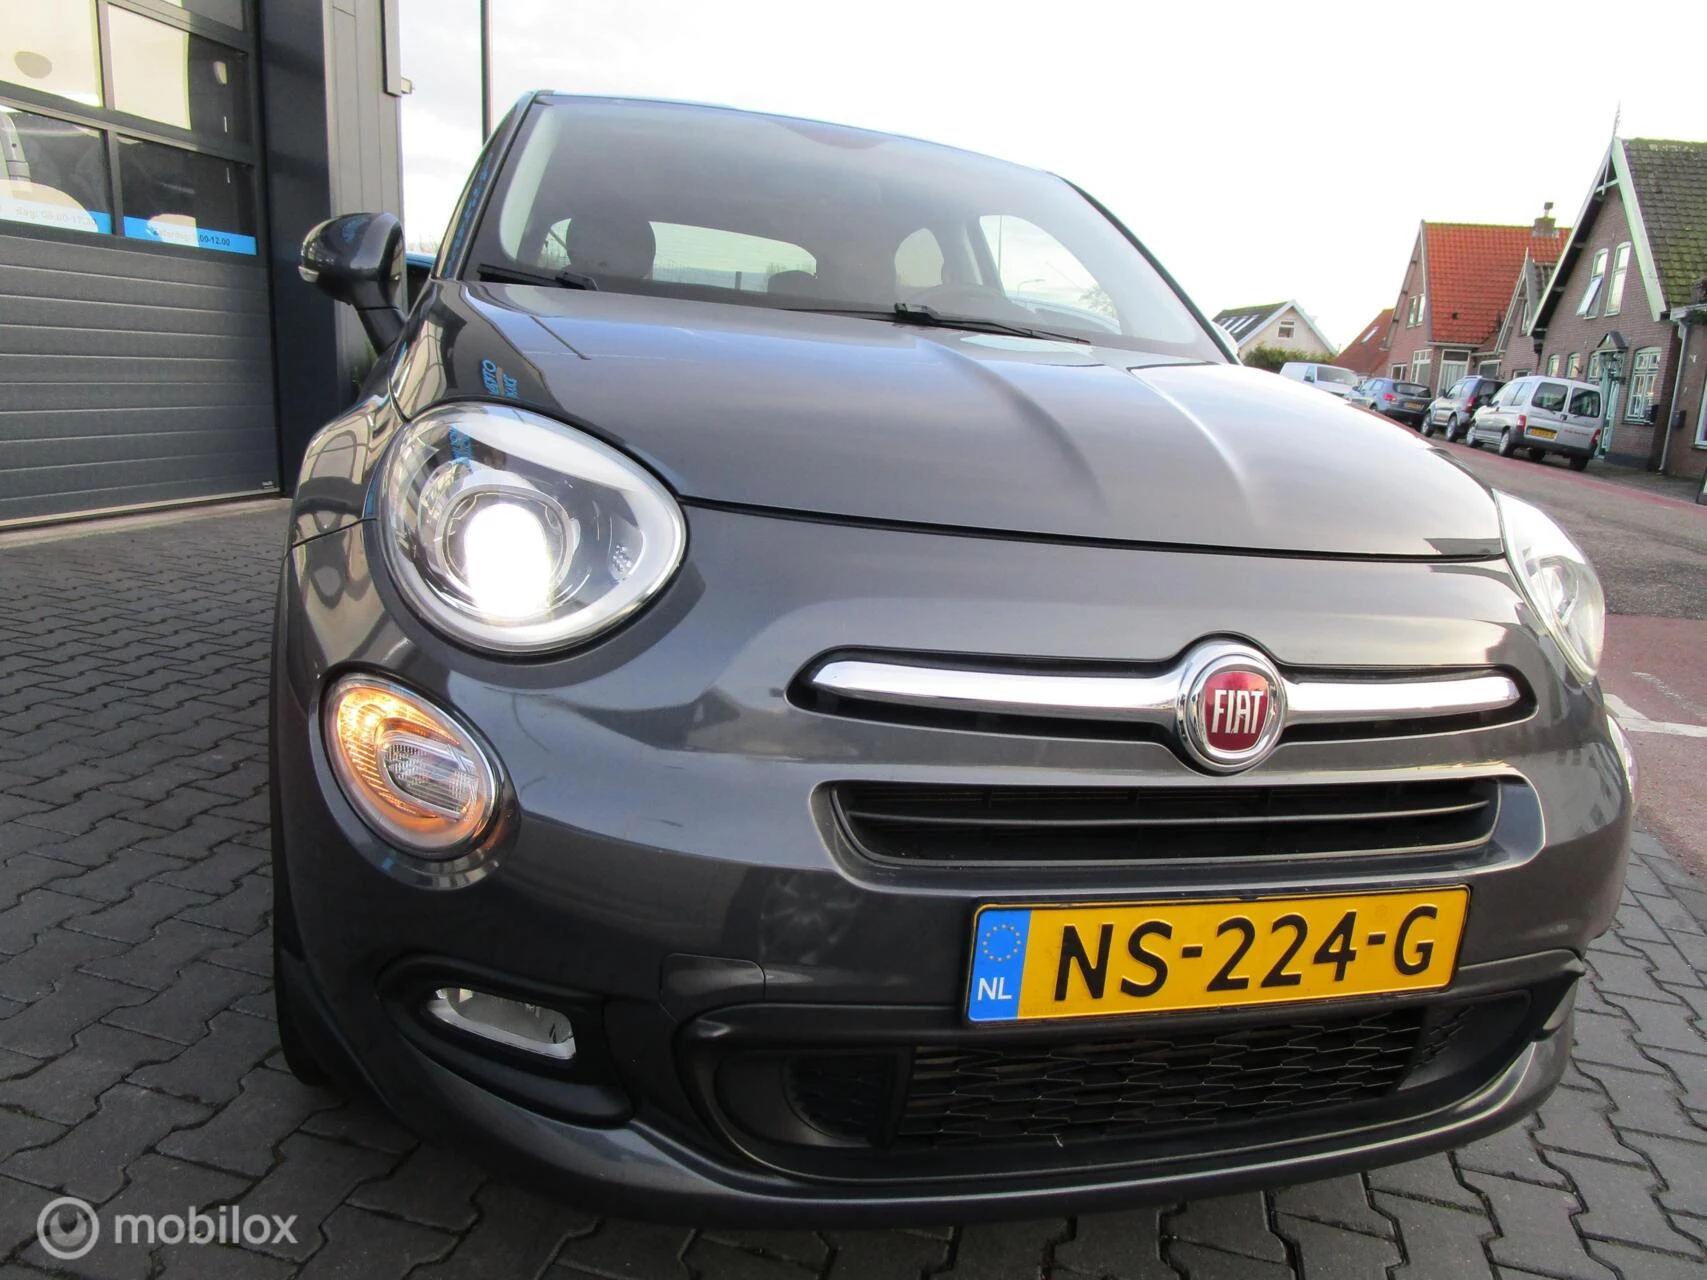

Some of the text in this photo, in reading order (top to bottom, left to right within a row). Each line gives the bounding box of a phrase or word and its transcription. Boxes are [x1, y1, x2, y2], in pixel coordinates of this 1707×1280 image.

[1211, 689, 1265, 734] FIAT
[1053, 904, 1438, 1002] NS-224-G
[977, 976, 1013, 1001] NL
